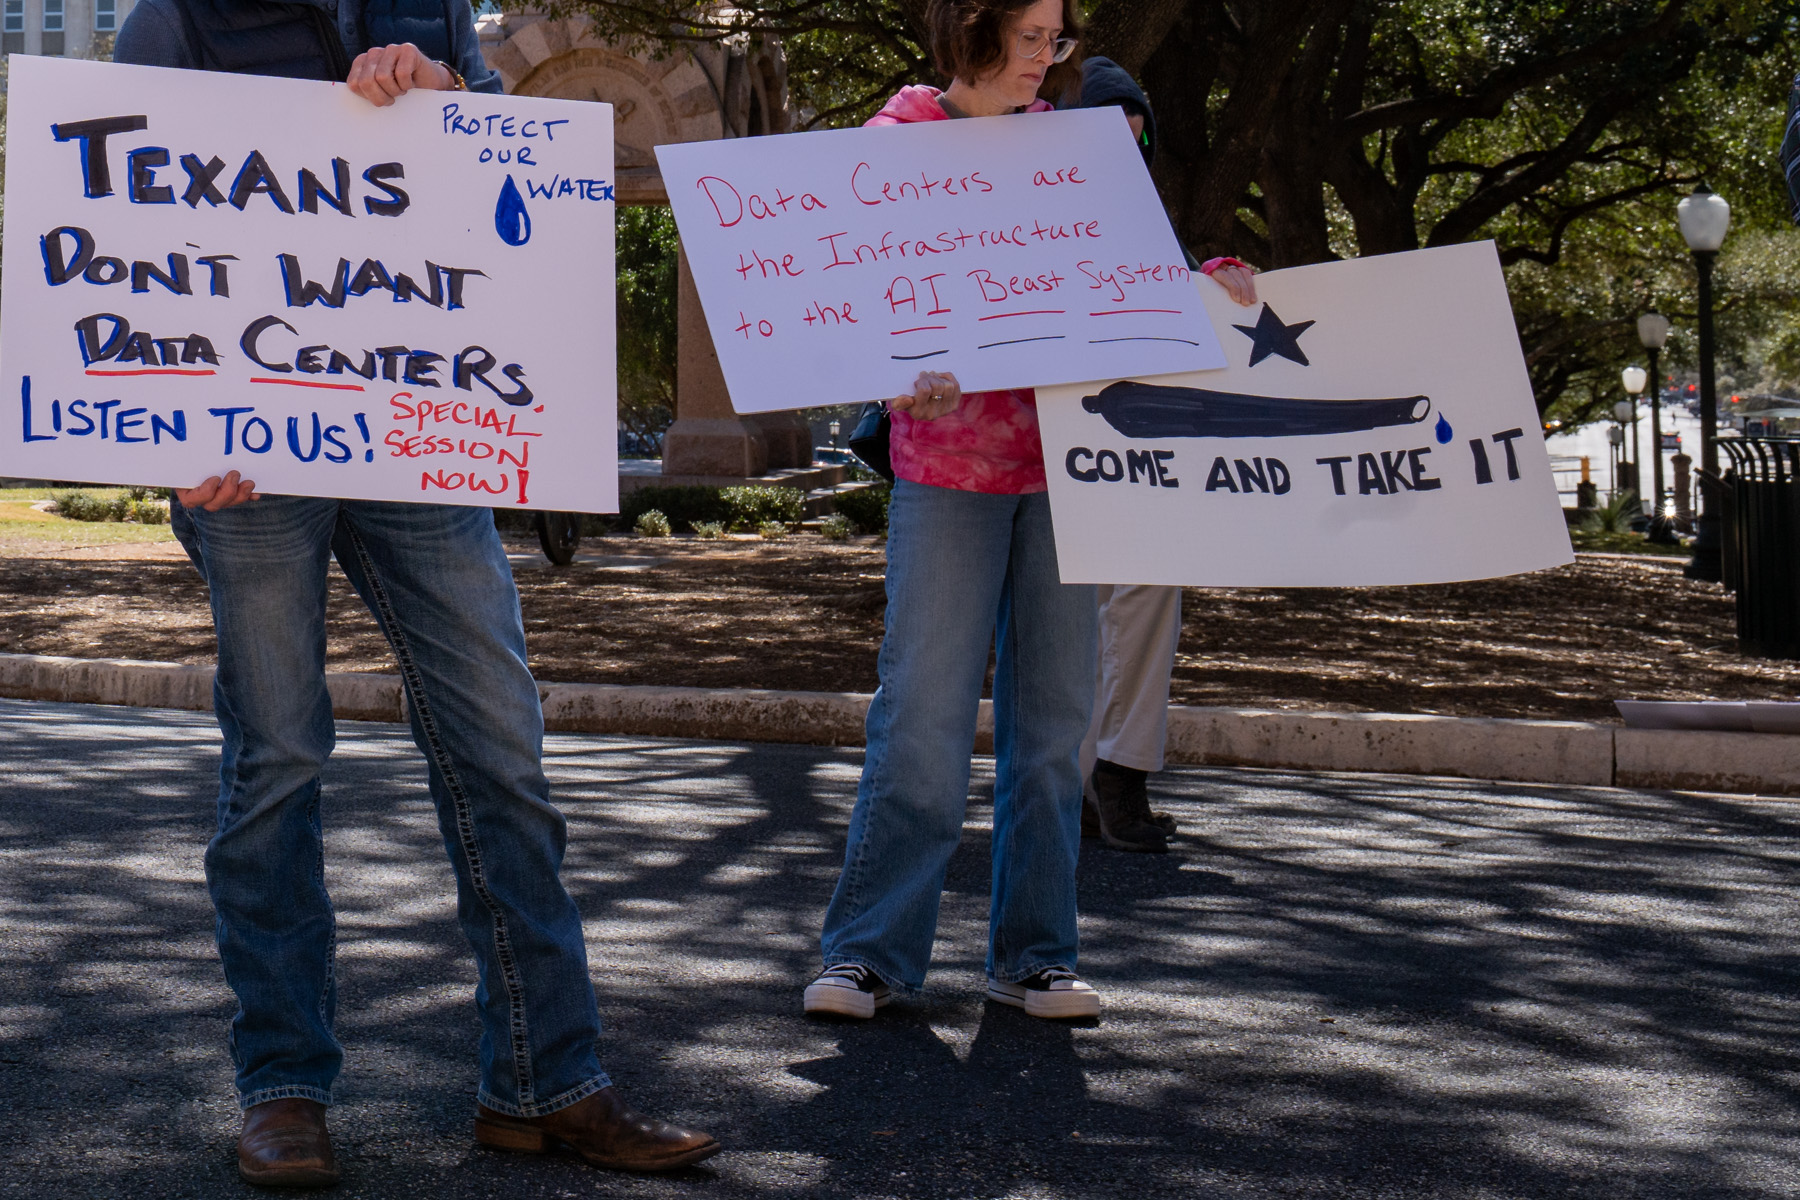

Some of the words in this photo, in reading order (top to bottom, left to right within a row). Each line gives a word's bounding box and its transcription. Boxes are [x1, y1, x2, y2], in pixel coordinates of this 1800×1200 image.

[443, 103, 569, 141] PROTECT
[50, 115, 411, 217] TEXANS
[479, 146, 537, 166] OUR
[526, 173, 615, 202] WATER
[696, 176, 827, 228] Data
[851, 161, 993, 206] Centers
[1032, 166, 1086, 187] are
[39, 226, 241, 299] DON'T
[276, 253, 492, 311] WANT
[736, 250, 805, 281] the
[817, 218, 1102, 271] Infrastructure
[735, 311, 774, 339] to
[802, 301, 859, 326] the
[883, 273, 953, 317] AI
[966, 269, 1066, 303] Beast
[1076, 260, 1190, 302] System
[74, 313, 224, 368] DATA
[240, 315, 534, 406] CENTERS
[21, 376, 187, 445] LISTEN
[207, 406, 274, 455] TO
[389, 392, 543, 437] SPECIAL
[384, 429, 529, 468] SESSION
[1065, 446, 1180, 489] COME
[1205, 456, 1292, 496] AND
[1315, 446, 1442, 496] TAKE
[1468, 427, 1524, 485] IT
[420, 468, 530, 504] NOW!
